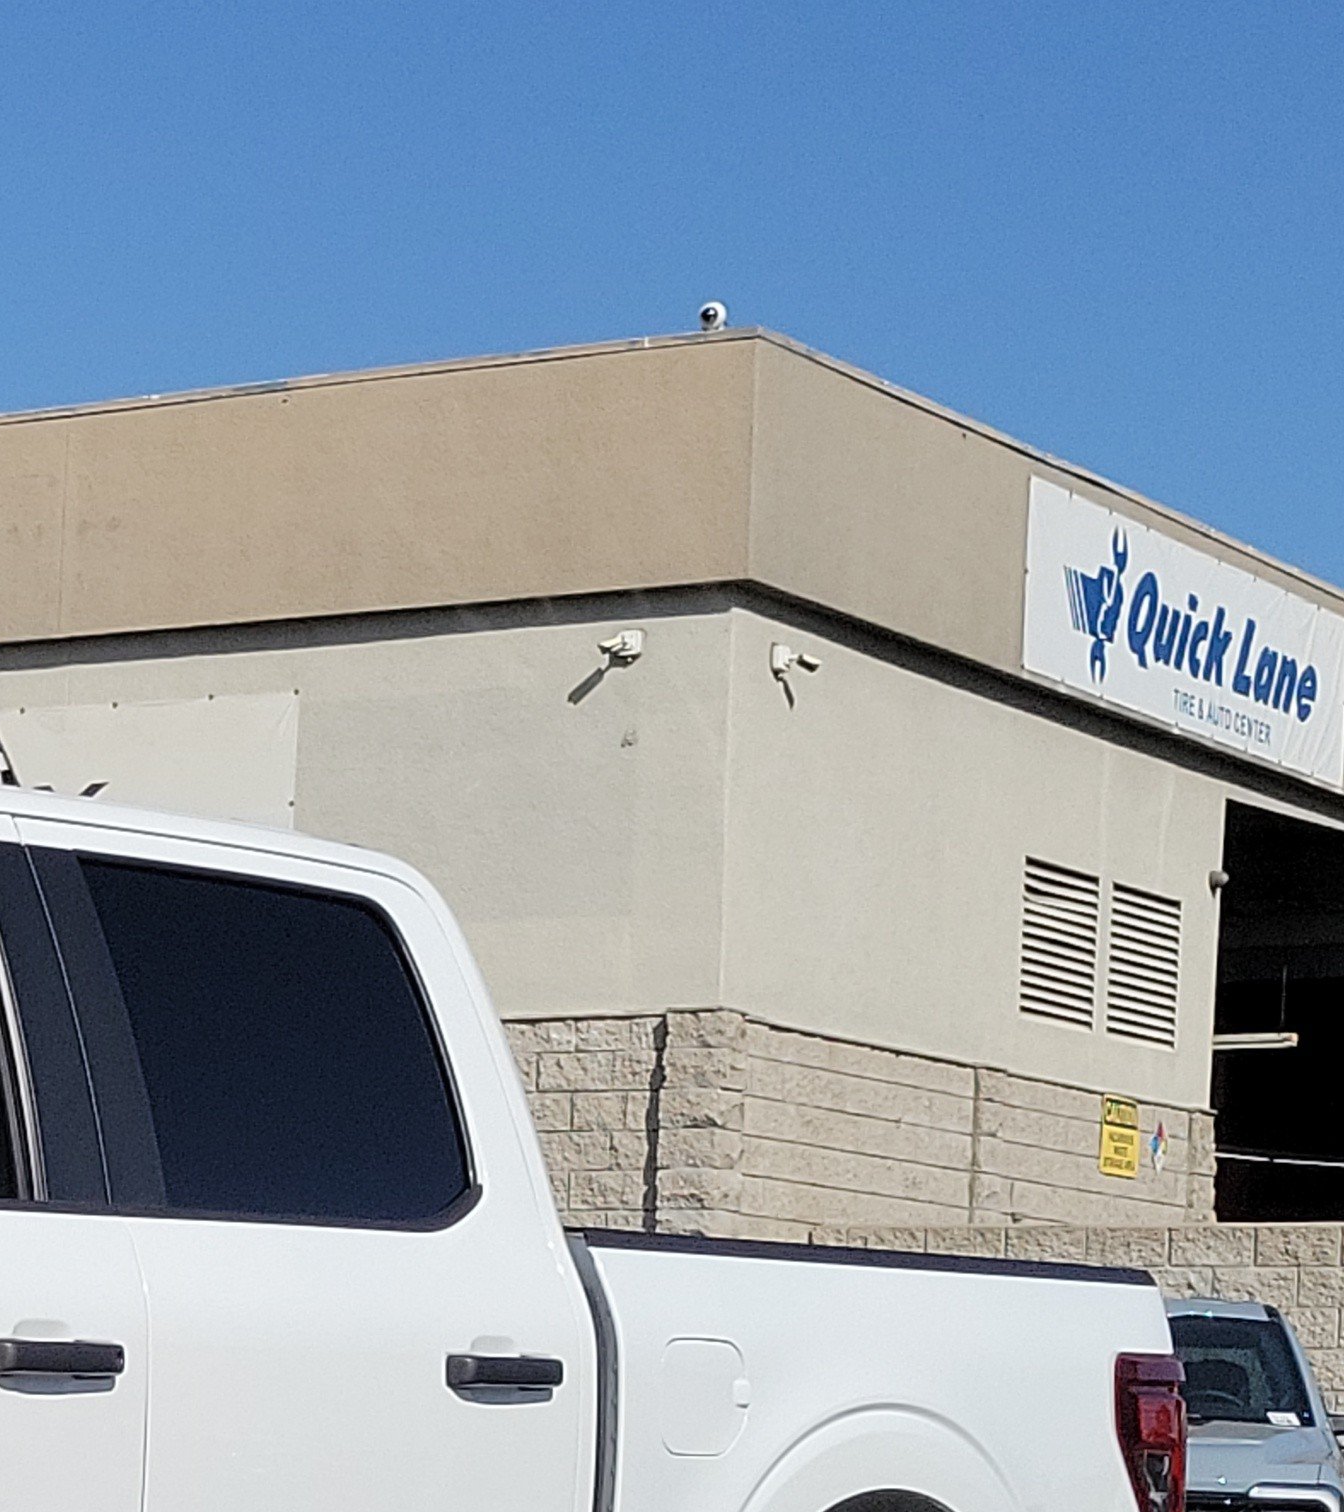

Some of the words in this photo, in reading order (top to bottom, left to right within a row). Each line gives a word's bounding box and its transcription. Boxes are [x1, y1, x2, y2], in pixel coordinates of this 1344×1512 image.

[1127, 571, 1233, 688] Quick
[1232, 618, 1318, 722] Lane
[1173, 687, 1196, 717] TIRE
[1206, 701, 1232, 730] AUTO
[1233, 711, 1272, 746] CENTER
